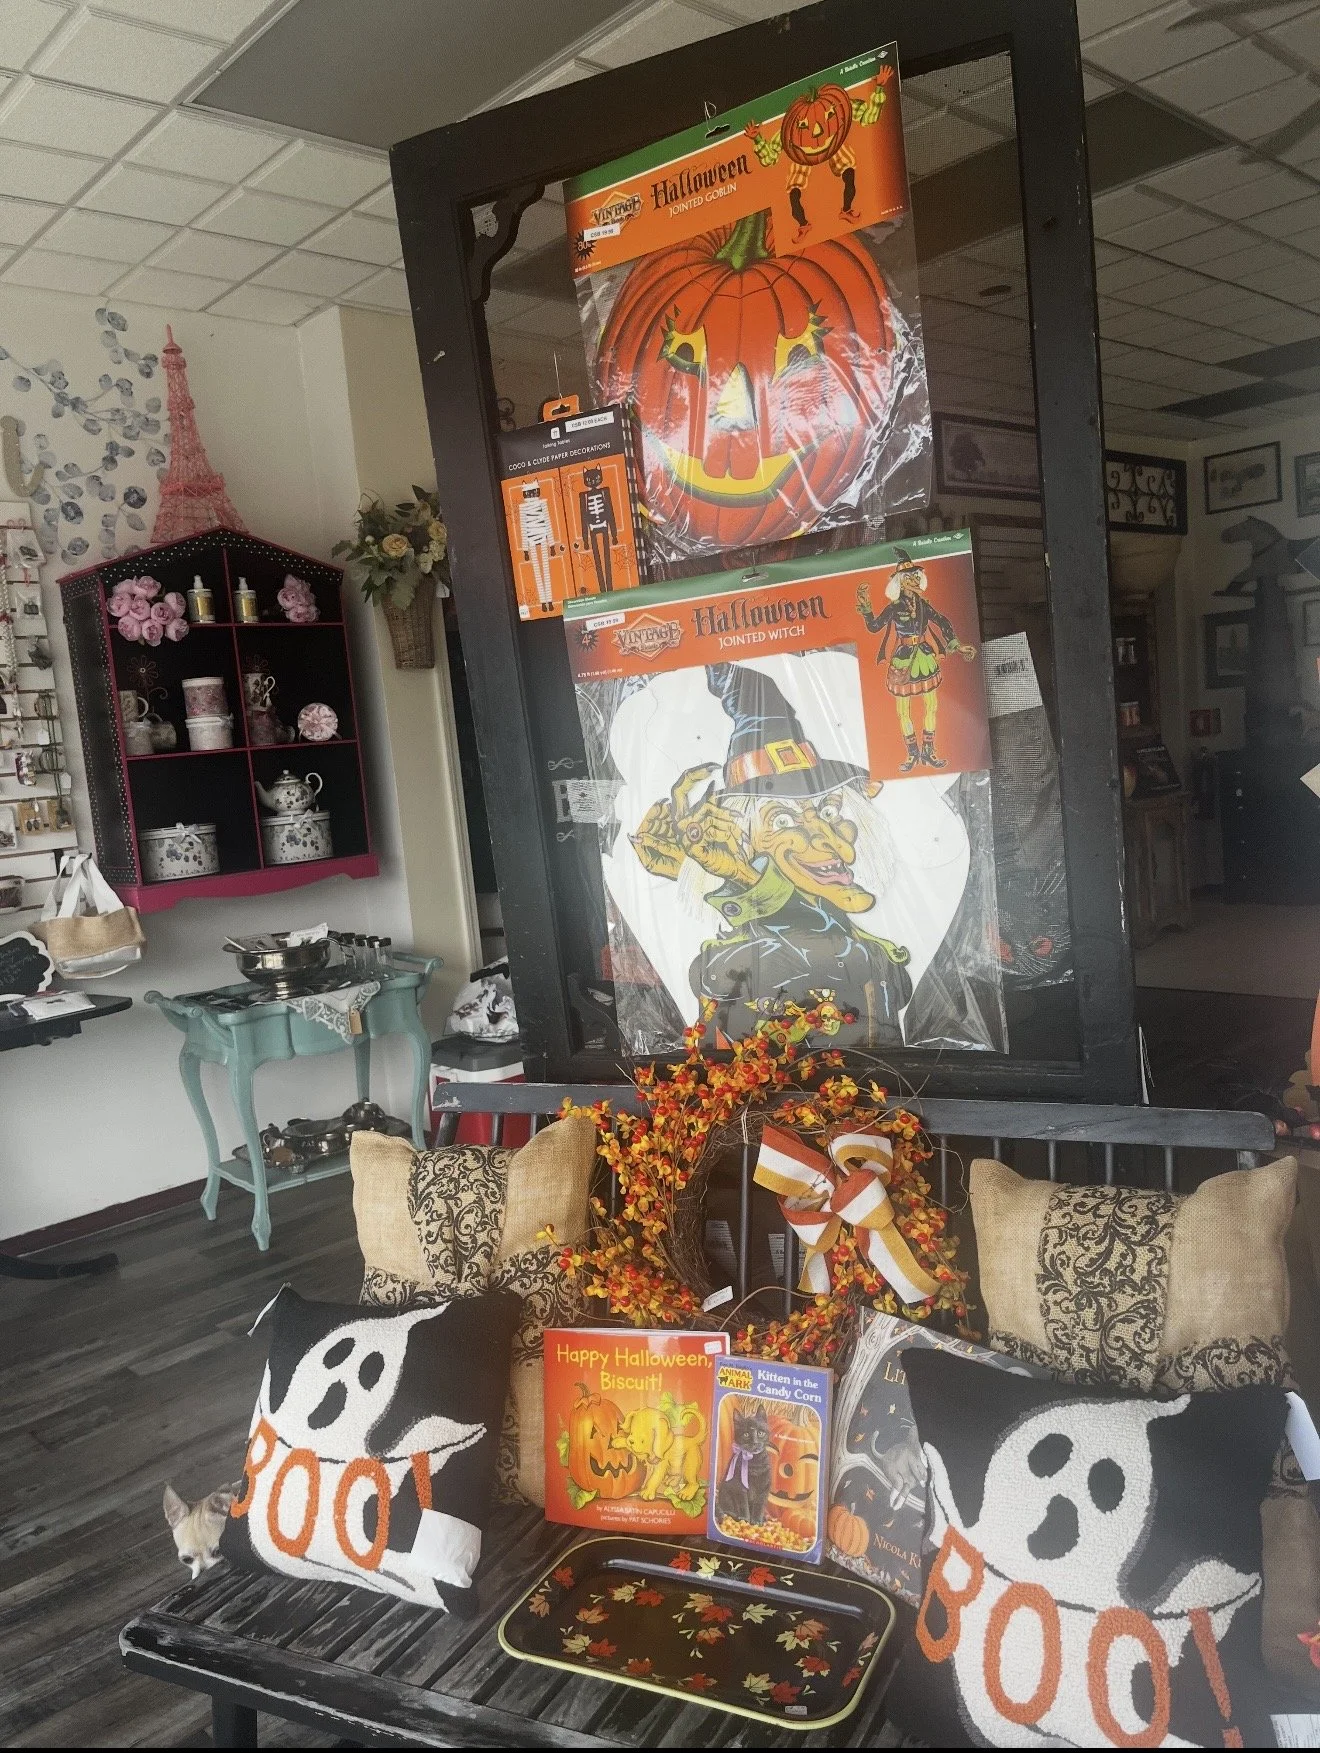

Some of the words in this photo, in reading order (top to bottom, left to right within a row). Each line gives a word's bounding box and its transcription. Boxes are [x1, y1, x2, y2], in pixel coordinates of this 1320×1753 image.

[651, 154, 752, 210] Halloween
[591, 194, 642, 226] VINTAGE
[669, 196, 704, 218] JOINTED
[705, 182, 737, 202] GOBLIN
[508, 461, 526, 471] COCO
[527, 459, 532, 467] &
[533, 455, 550, 466] CLYDE
[551, 451, 569, 463] PAPER
[570, 441, 611, 457] DECORATIONS
[691, 594, 832, 637] Halloween
[615, 621, 679, 646] VINTAGE
[718, 631, 766, 650] JOINTED
[768, 624, 806, 641] WITCH
[556, 1343, 609, 1370] Happy
[614, 1346, 713, 1369] Halloween,
[600, 1370, 663, 1392] Biscuit!
[719, 1367, 753, 1380] ANIMAL
[728, 1378, 751, 1390] ARK
[757, 1369, 791, 1385] Kitten
[792, 1377, 802, 1386] in
[803, 1378, 819, 1389] the
[756, 1382, 792, 1400] Candy
[793, 1388, 822, 1403] Corn
[916, 1524, 1243, 1748] BOO!
